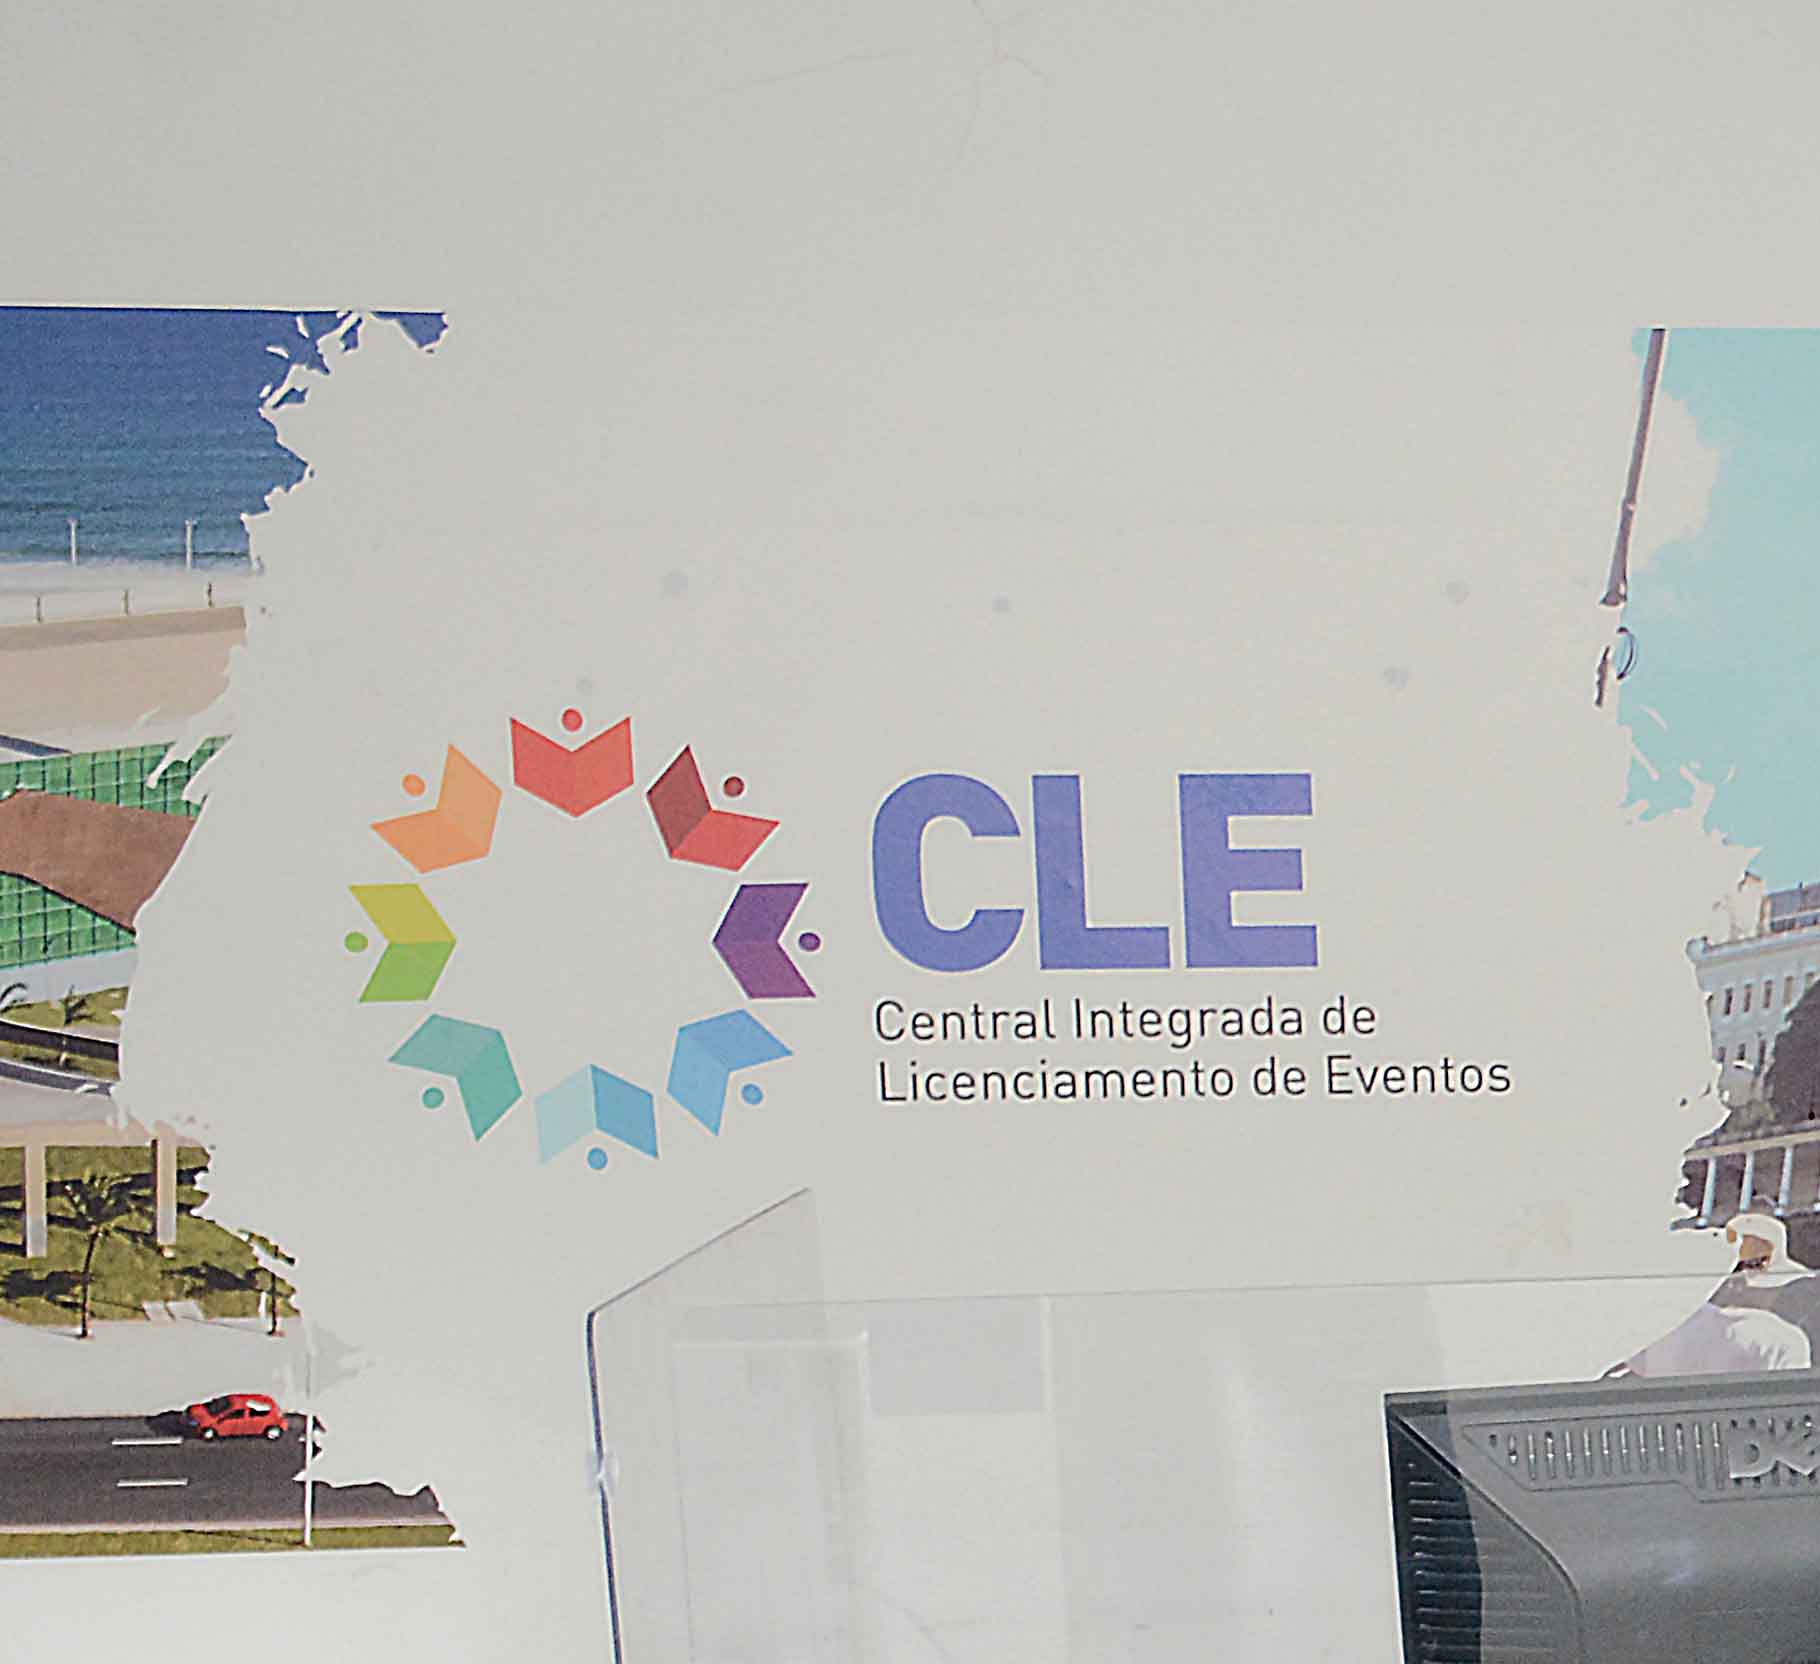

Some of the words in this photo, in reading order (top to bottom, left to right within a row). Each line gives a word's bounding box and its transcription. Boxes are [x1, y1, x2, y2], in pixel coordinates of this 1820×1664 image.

[871, 772, 1319, 973] CLE
[874, 998, 1056, 1042] Central
[1074, 996, 1303, 1049] Integrada
[1322, 996, 1376, 1036] de
[879, 1059, 1235, 1102] Licenciamento
[1253, 1057, 1307, 1096] de
[1327, 1055, 1512, 1095] Eventos
